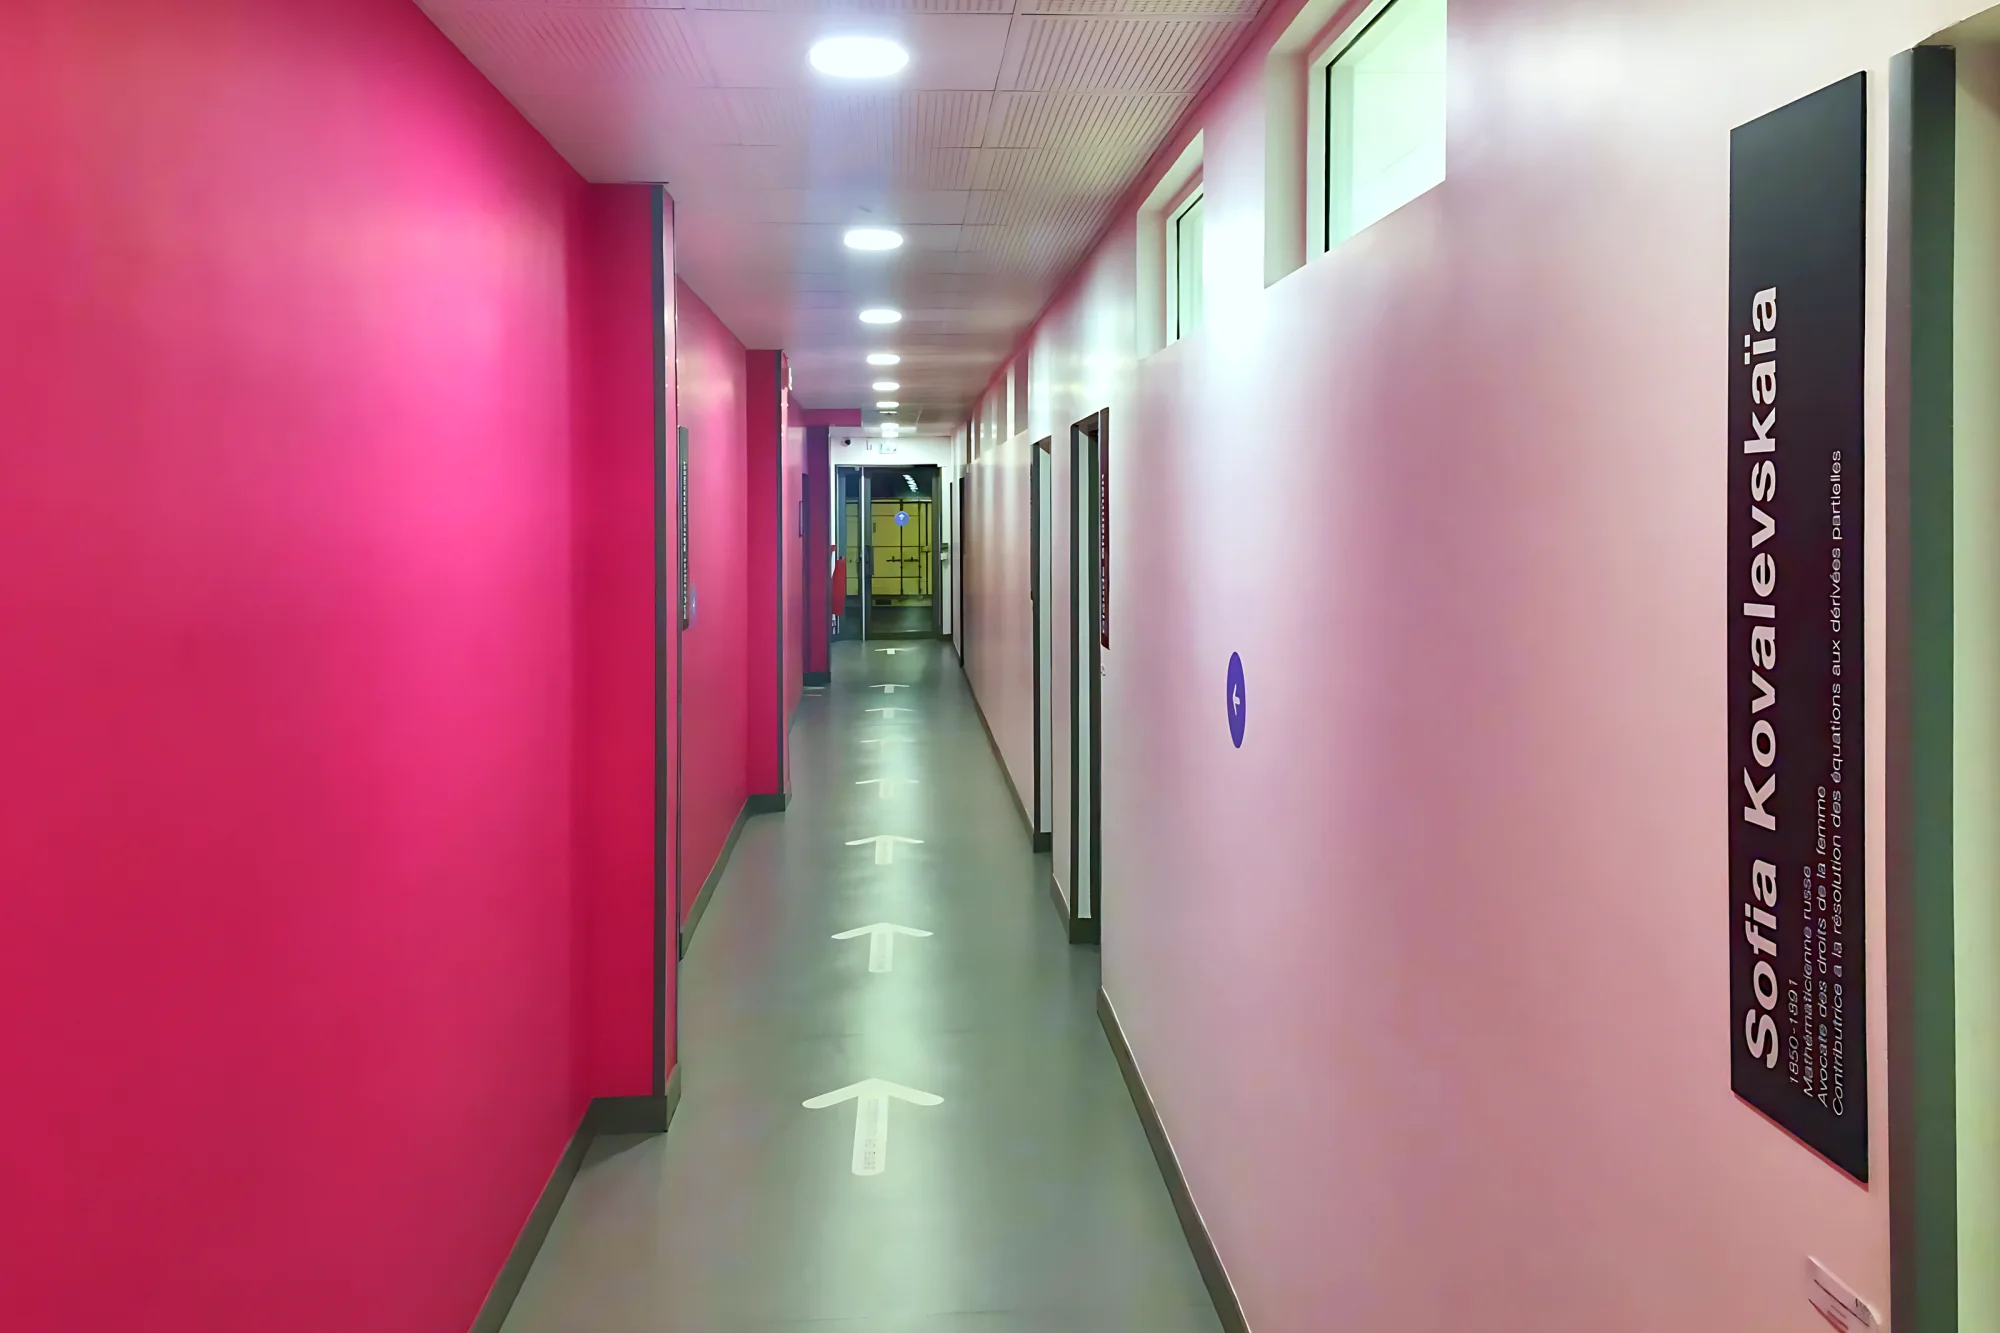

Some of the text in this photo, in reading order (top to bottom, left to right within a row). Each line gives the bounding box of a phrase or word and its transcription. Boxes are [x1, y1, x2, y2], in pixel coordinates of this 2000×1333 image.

[1830, 450, 1843, 540] partielles
[1829, 547, 1841, 633] dérivées
[1743, 286, 1779, 1070] Sofia Kovalevskaïa
[1832, 639, 1841, 676] aux
[1830, 683, 1843, 784] équations
[1830, 790, 1842, 828] des
[1830, 834, 1843, 935] résolution
[1802, 865, 1814, 1098] Mathématicienne russe
[1815, 785, 1828, 1108] Avocate des droits de la femme
[1831, 941, 1843, 958] la
[1832, 982, 1844, 1116] Contributrice
